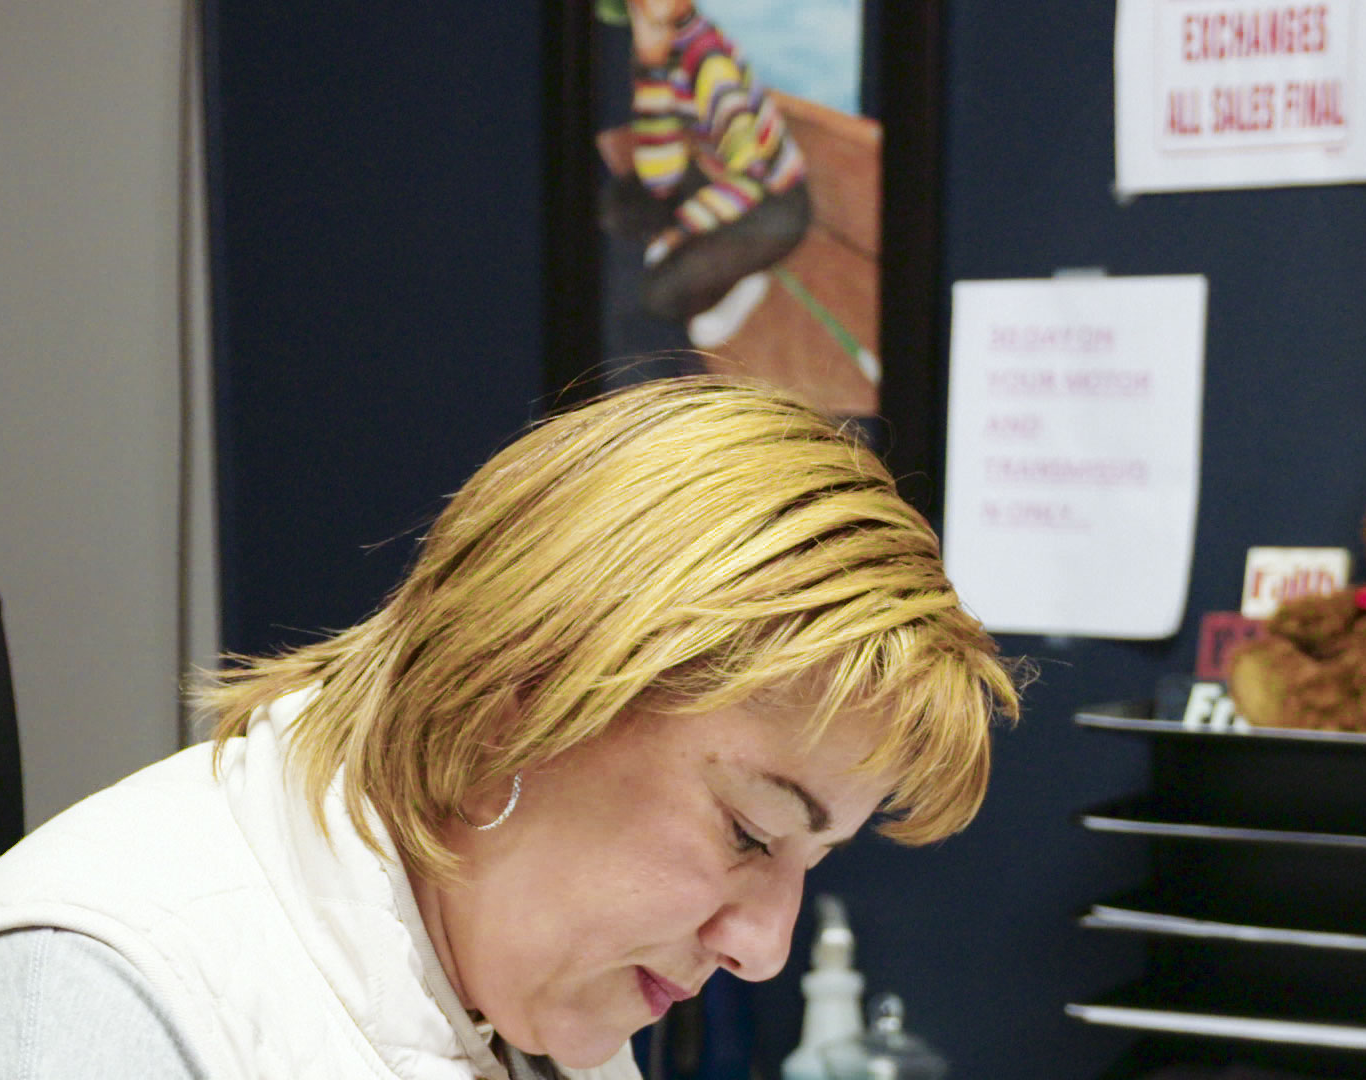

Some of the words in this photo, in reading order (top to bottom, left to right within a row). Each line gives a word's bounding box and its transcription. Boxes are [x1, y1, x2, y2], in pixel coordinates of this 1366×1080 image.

[1182, 6, 1328, 62] EXCHANGES
[1164, 86, 1201, 136] ALL
[1211, 82, 1276, 134] SALES
[1283, 78, 1345, 130] FINAL
[987, 369, 1056, 398] YOUR
[1065, 369, 1151, 398] MOTOR
[985, 413, 1041, 441] AND
